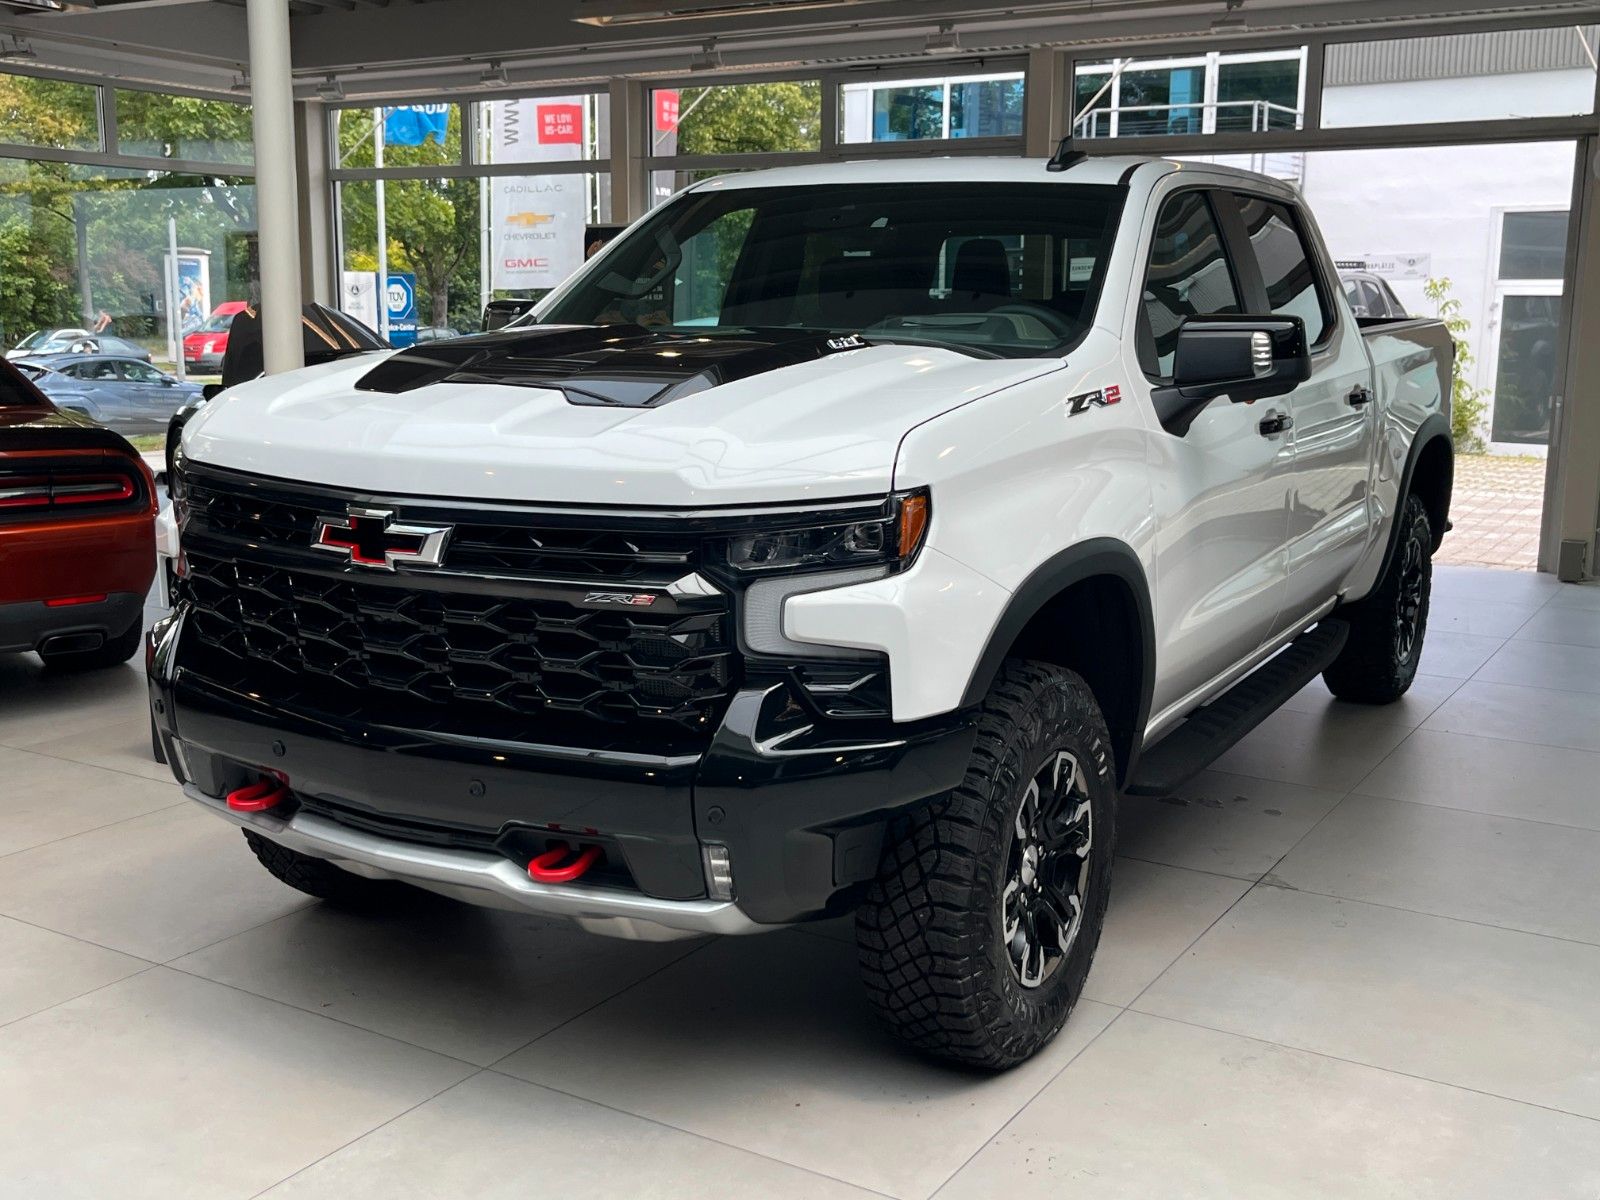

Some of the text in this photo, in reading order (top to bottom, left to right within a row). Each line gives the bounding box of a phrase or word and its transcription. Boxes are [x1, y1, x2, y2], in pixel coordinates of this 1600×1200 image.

[503, 184, 563, 194] CADILLAC
[503, 232, 556, 240] CHEVROLET
[505, 258, 548, 268] GMC
[1066, 384, 1121, 417] ZR2
[583, 592, 656, 606] ZR2
